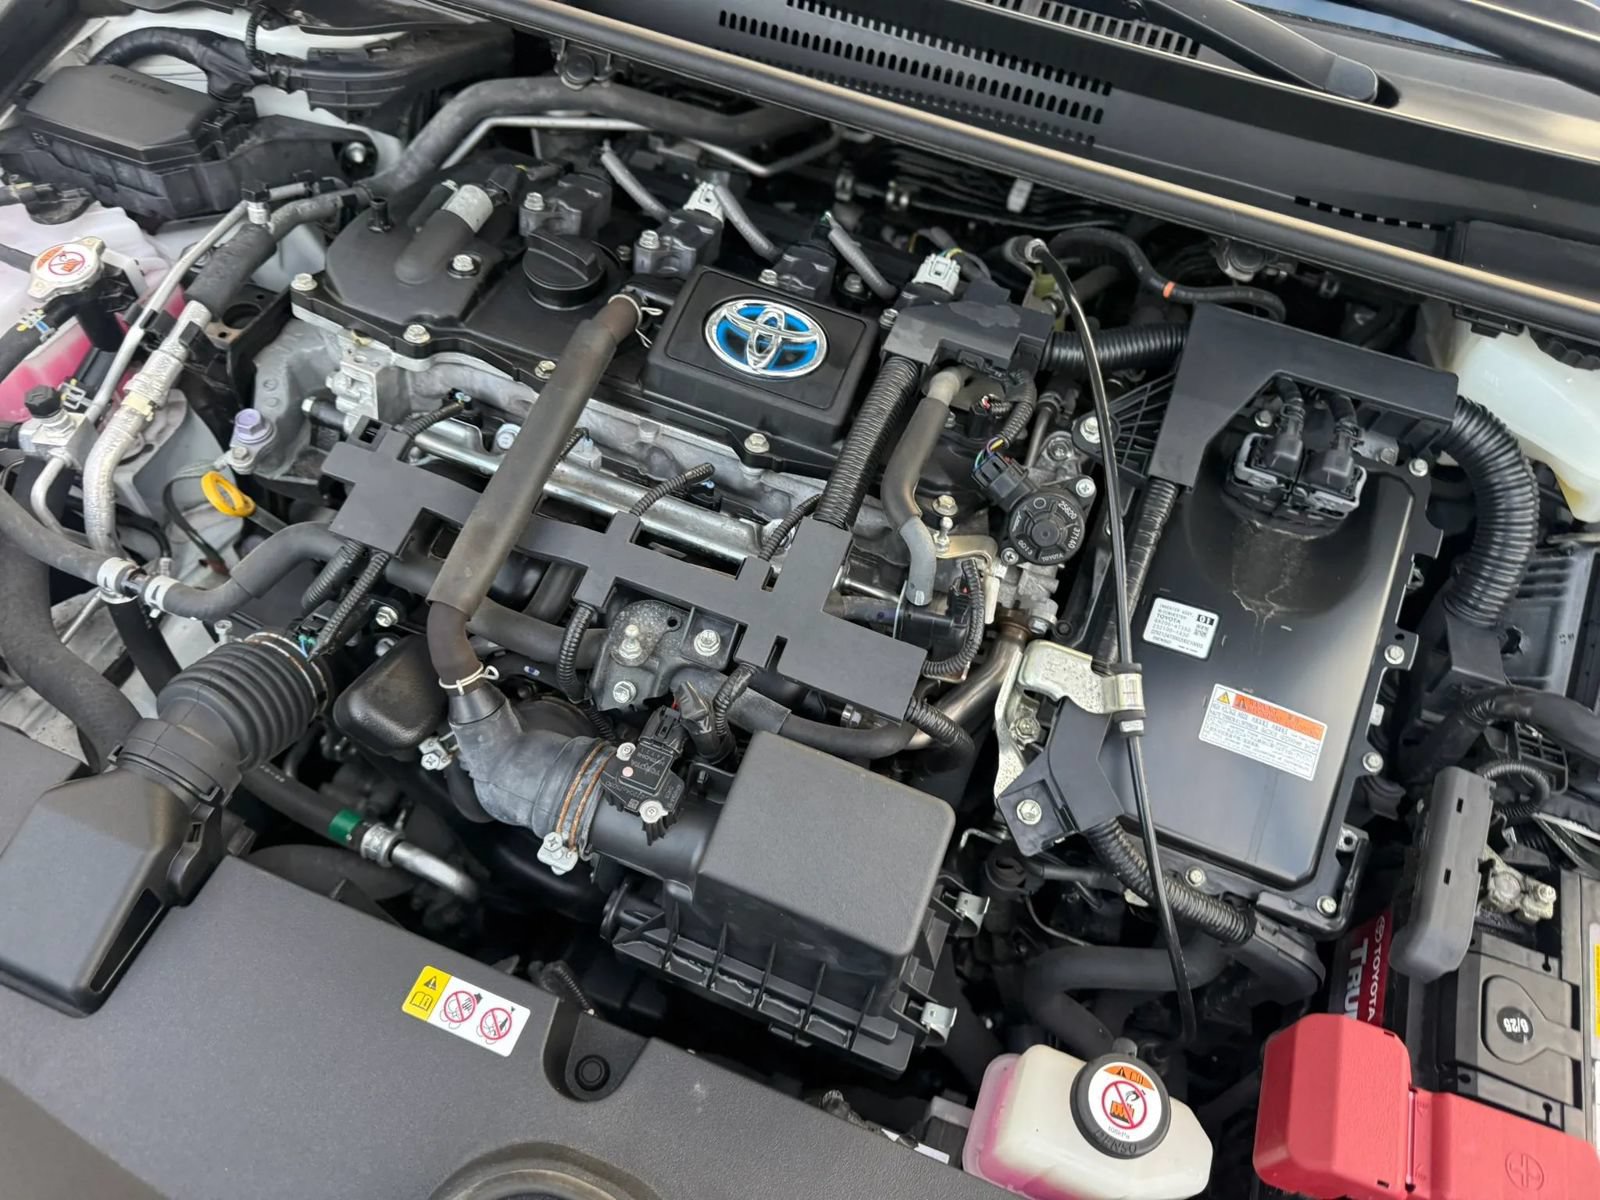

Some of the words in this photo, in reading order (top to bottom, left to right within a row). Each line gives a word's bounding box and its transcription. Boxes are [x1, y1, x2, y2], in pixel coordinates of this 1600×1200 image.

[1067, 527, 1081, 549] 37140
[1041, 552, 1065, 563] TOYOTA
[1156, 613, 1181, 624] TOYOTA
[1367, 943, 1382, 1022] TOYOTA
[1095, 1129, 1137, 1154] DENSO
